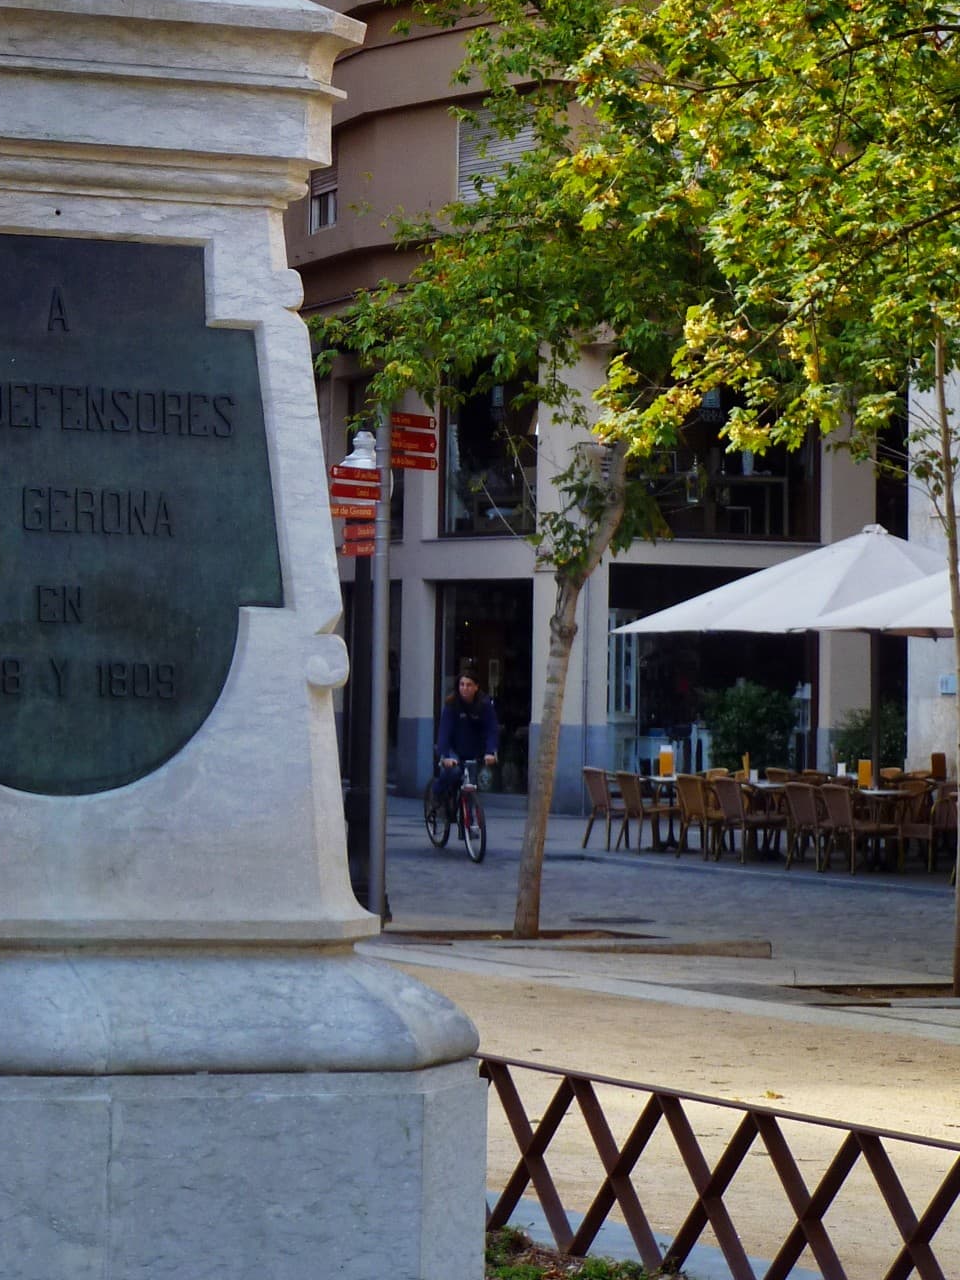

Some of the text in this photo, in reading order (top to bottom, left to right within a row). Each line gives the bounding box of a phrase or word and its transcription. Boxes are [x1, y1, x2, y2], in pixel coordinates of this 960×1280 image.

[46, 285, 71, 333] A
[21, 484, 176, 538] GERONA
[35, 582, 85, 625] EN
[48, 657, 72, 698] Y
[95, 658, 179, 700] 1809
